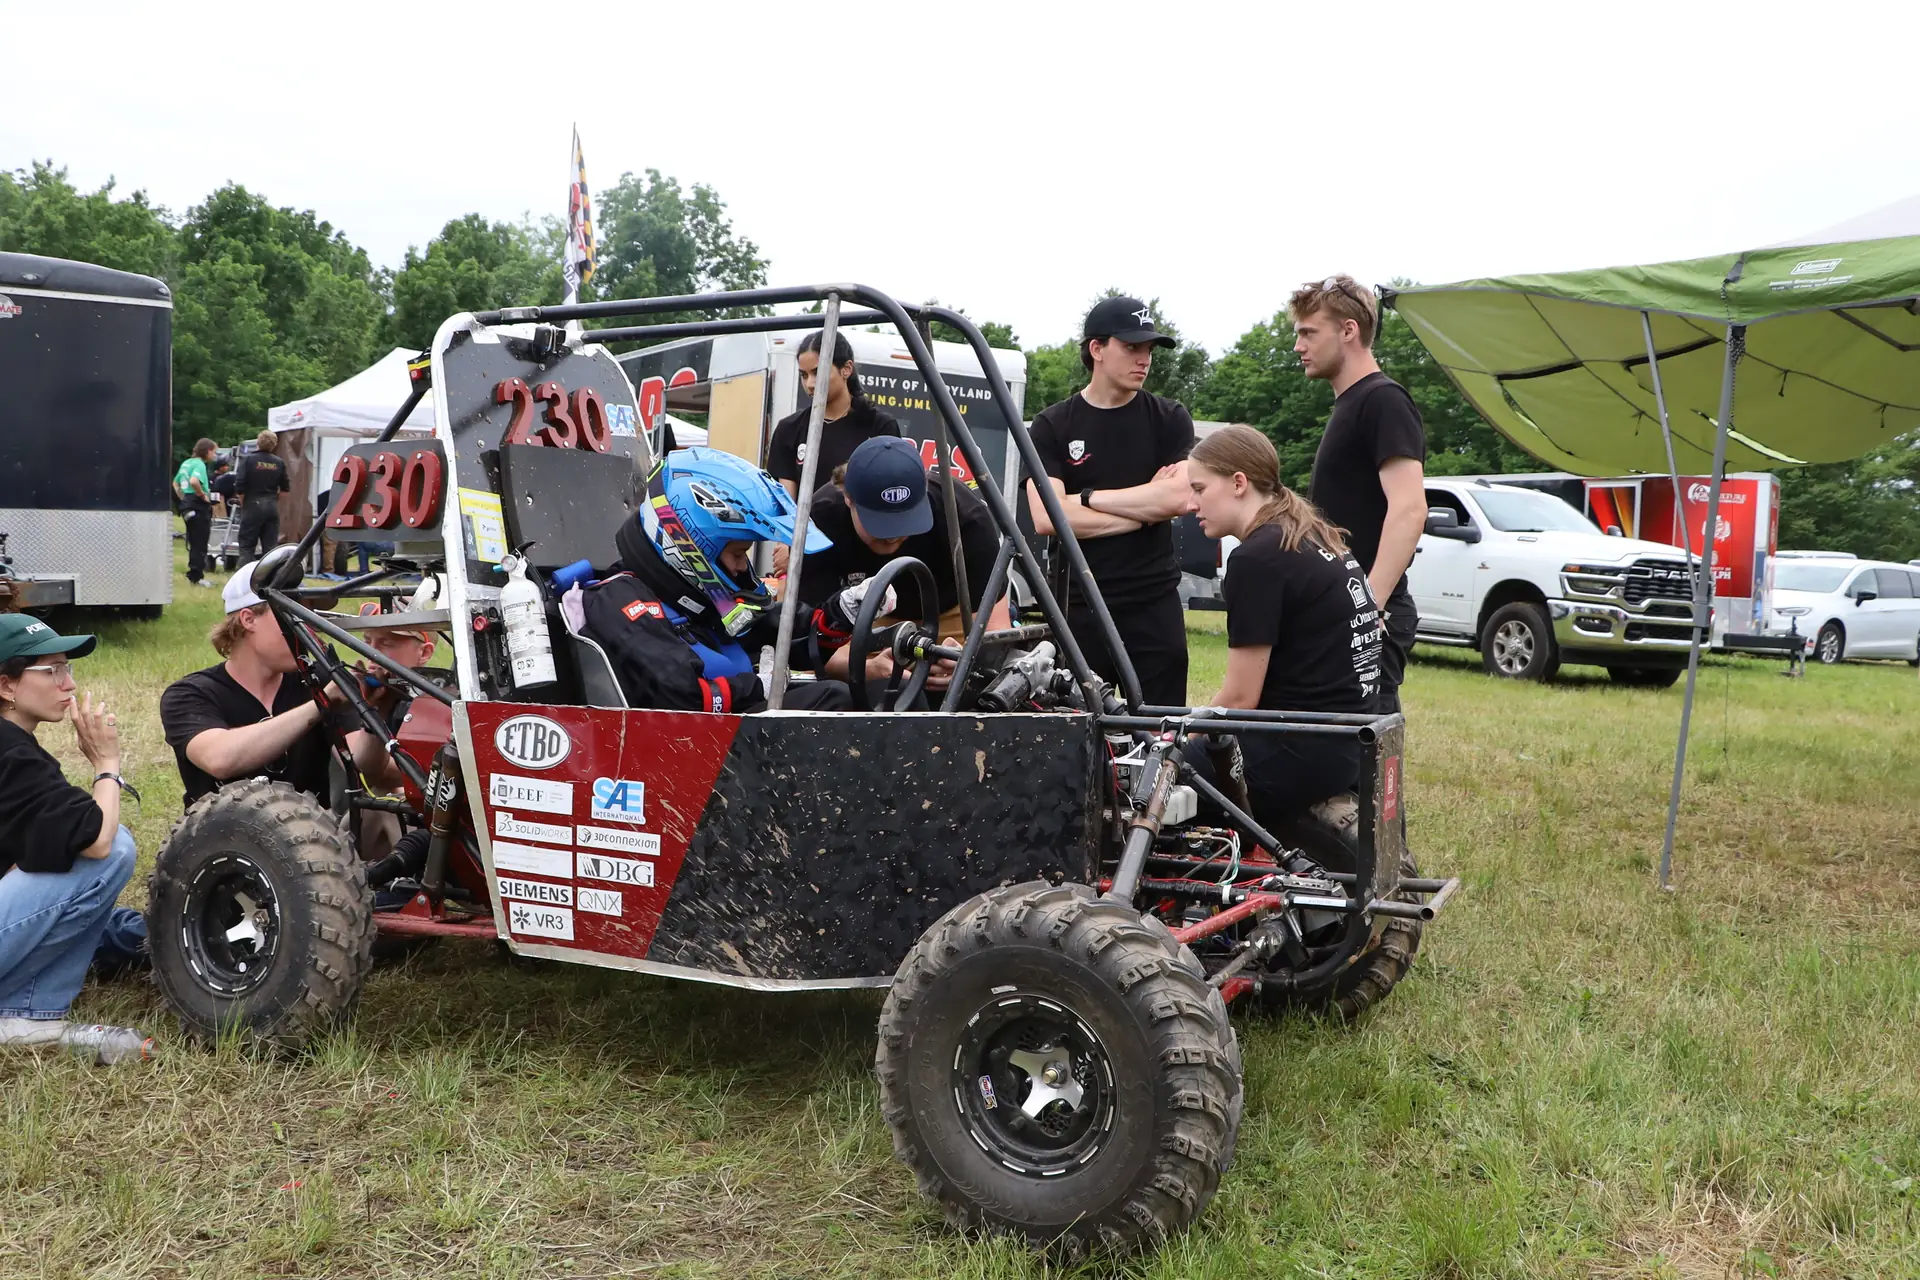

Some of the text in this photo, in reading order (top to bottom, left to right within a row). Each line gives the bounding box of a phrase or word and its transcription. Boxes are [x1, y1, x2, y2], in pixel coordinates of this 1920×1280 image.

[859, 374, 992, 400] RSITY OF RYLAND
[496, 377, 612, 453] 230
[326, 450, 441, 529] 230
[884, 488, 908, 501] ETBO
[503, 722, 561, 762] ETBO
[517, 787, 544, 802] EEF
[593, 778, 642, 813] SAE
[593, 811, 641, 822] INTERNATIONAL
[515, 824, 570, 840] SOLIDWORKS
[599, 858, 653, 885] DBG
[500, 880, 569, 903] SIEMENS
[578, 890, 621, 914] QNX
[534, 912, 564, 930] VR3
